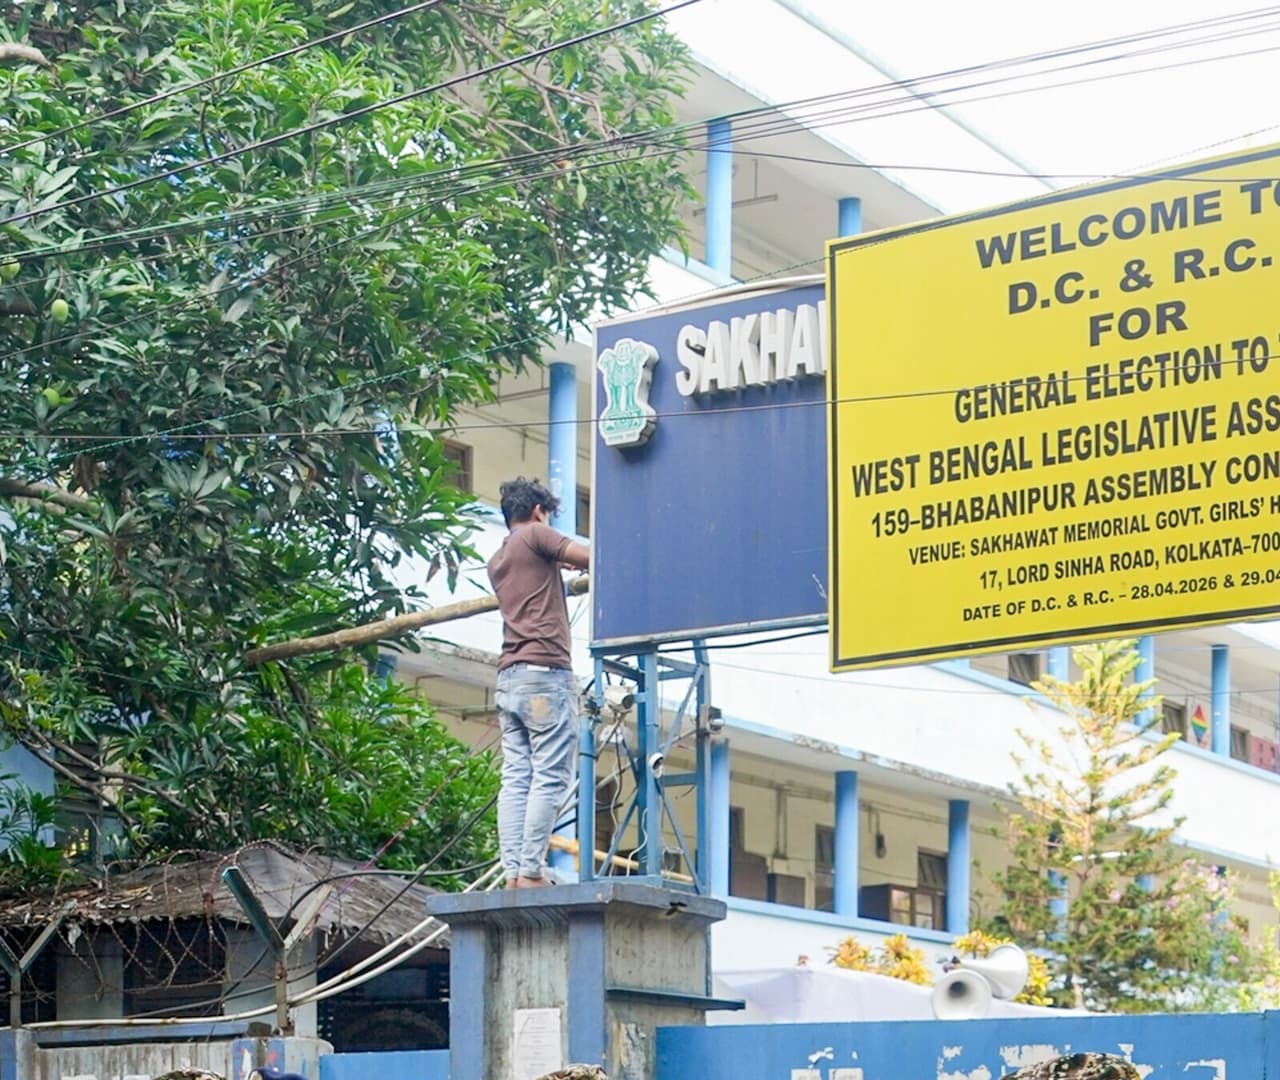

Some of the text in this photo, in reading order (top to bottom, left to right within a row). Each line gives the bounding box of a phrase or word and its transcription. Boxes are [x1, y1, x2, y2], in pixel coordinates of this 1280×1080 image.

[975, 190, 1222, 268] WELCOME
[1008, 239, 1272, 315] D.C. & R.C.
[1089, 300, 1188, 347] FOR
[954, 371, 1077, 423] GENERAL
[1085, 344, 1221, 402] ELECTION
[1232, 334, 1268, 376] TO
[851, 454, 920, 498] WEST
[929, 438, 1032, 487] BENGAL
[1041, 404, 1217, 470] LEGISLATIVE
[1083, 460, 1216, 507] ASSEMBLY
[909, 539, 965, 566] VENUE:
[970, 525, 1058, 556] SAKHAWAT
[1063, 513, 1150, 545] MEMORIAL
[1155, 506, 1204, 533] GOVT.
[963, 603, 1000, 622] DATE
[1005, 601, 1026, 617] OF
[1031, 595, 1062, 614] D.C.
[1067, 593, 1078, 608] &
[1083, 588, 1114, 608] R.C.
[1131, 573, 1218, 601] 28.04.2026
[1223, 574, 1235, 588] &
[979, 569, 1002, 591] 17,
[1007, 565, 1049, 587] LORD
[1055, 556, 1105, 581] SINHA
[1110, 550, 1160, 575] ROAD,
